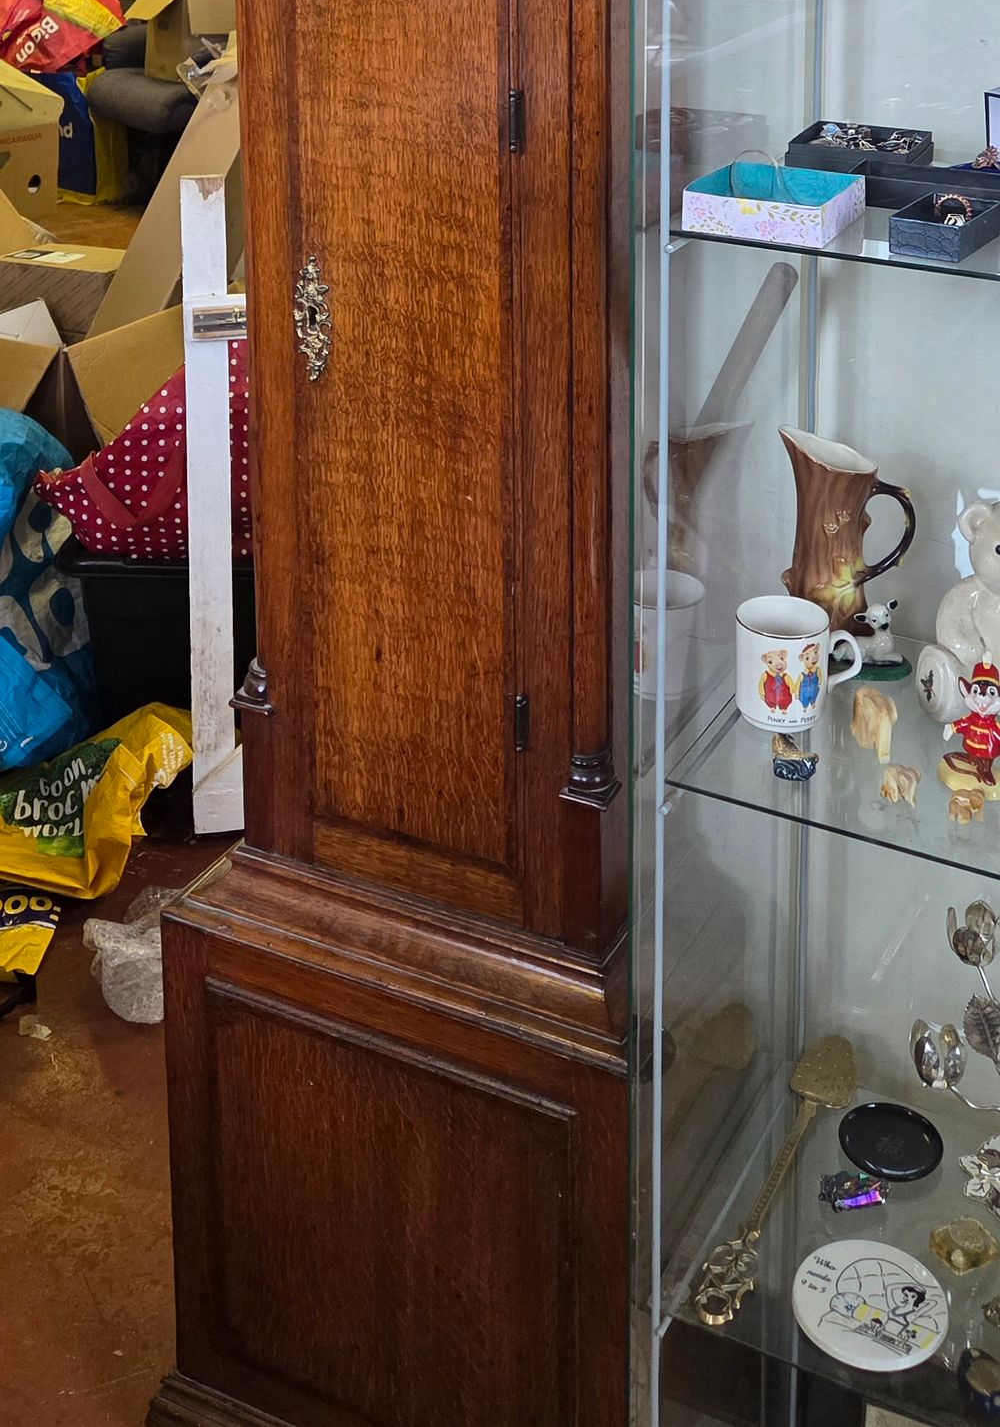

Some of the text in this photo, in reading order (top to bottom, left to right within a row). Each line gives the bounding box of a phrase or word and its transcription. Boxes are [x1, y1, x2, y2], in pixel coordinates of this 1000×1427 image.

[19, 817, 84, 838] worl
[813, 1256, 836, 1270] Who
[806, 1270, 832, 1282] needs
